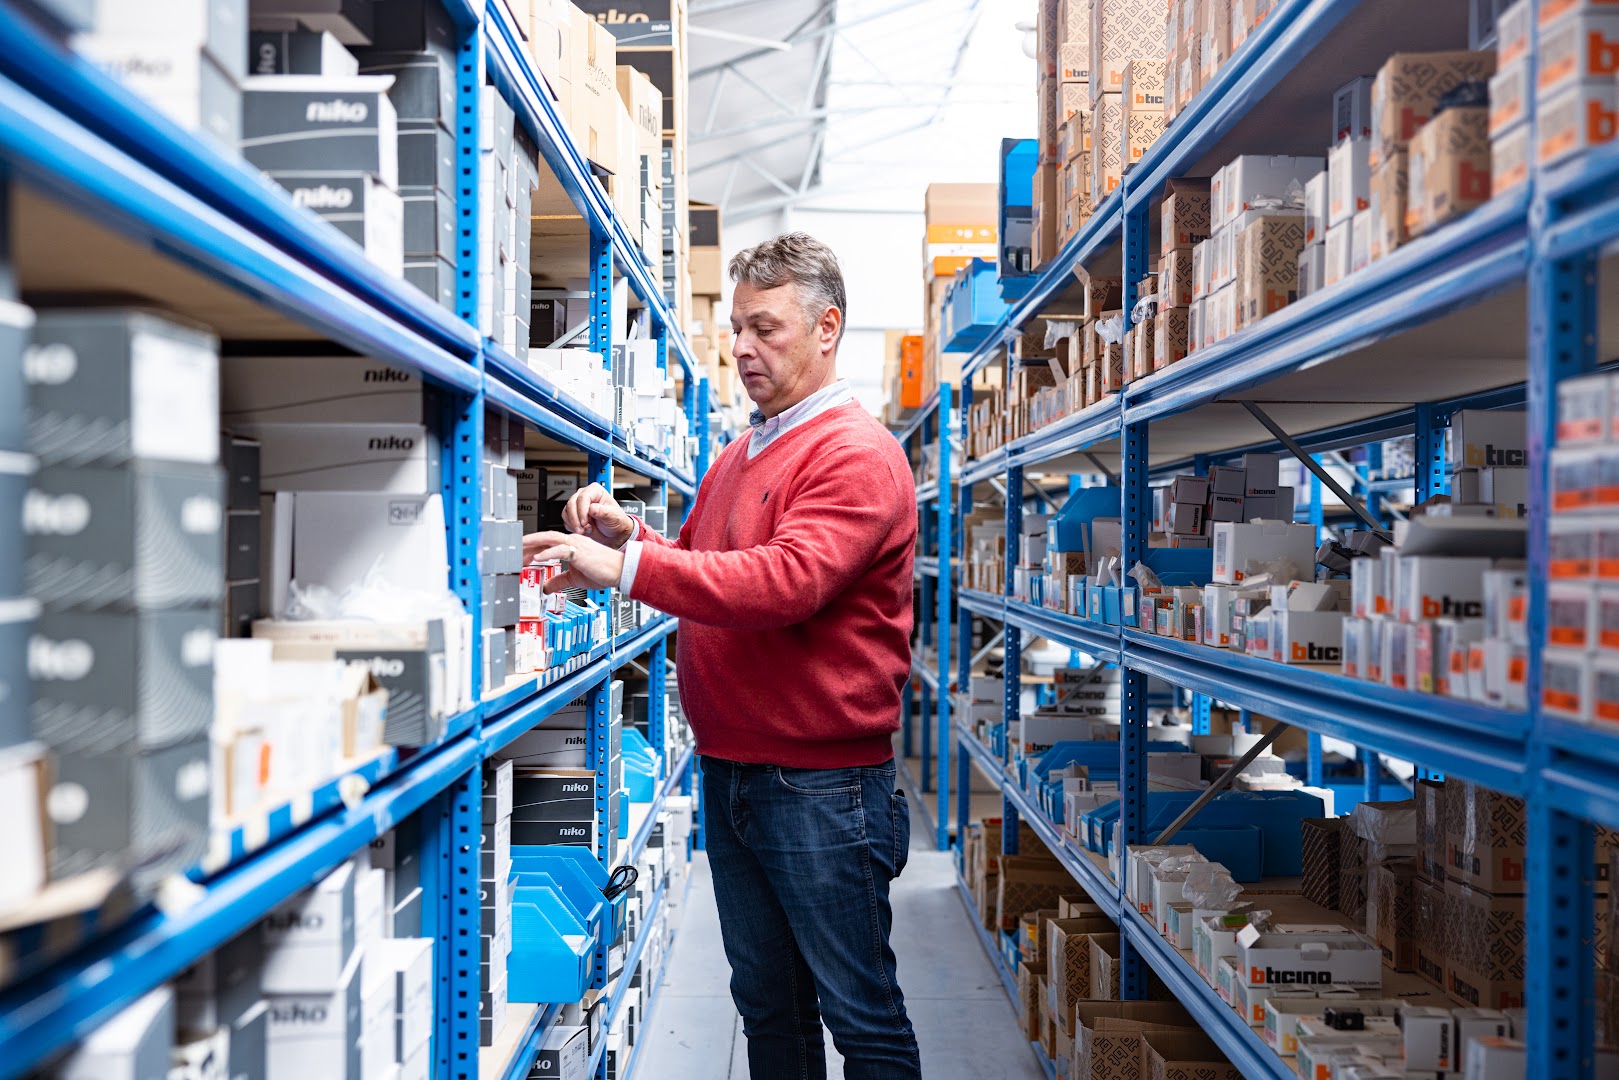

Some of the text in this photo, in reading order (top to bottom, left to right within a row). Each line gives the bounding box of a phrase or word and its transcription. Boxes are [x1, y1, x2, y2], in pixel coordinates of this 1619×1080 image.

[1065, 69, 1089, 78] btic
[306, 99, 368, 122] niko
[364, 367, 410, 382] niko
[368, 435, 414, 450] niko
[1291, 641, 1342, 661] btic
[562, 783, 589, 792] niko
[559, 827, 586, 836] niko
[1251, 966, 1332, 985] bticino
